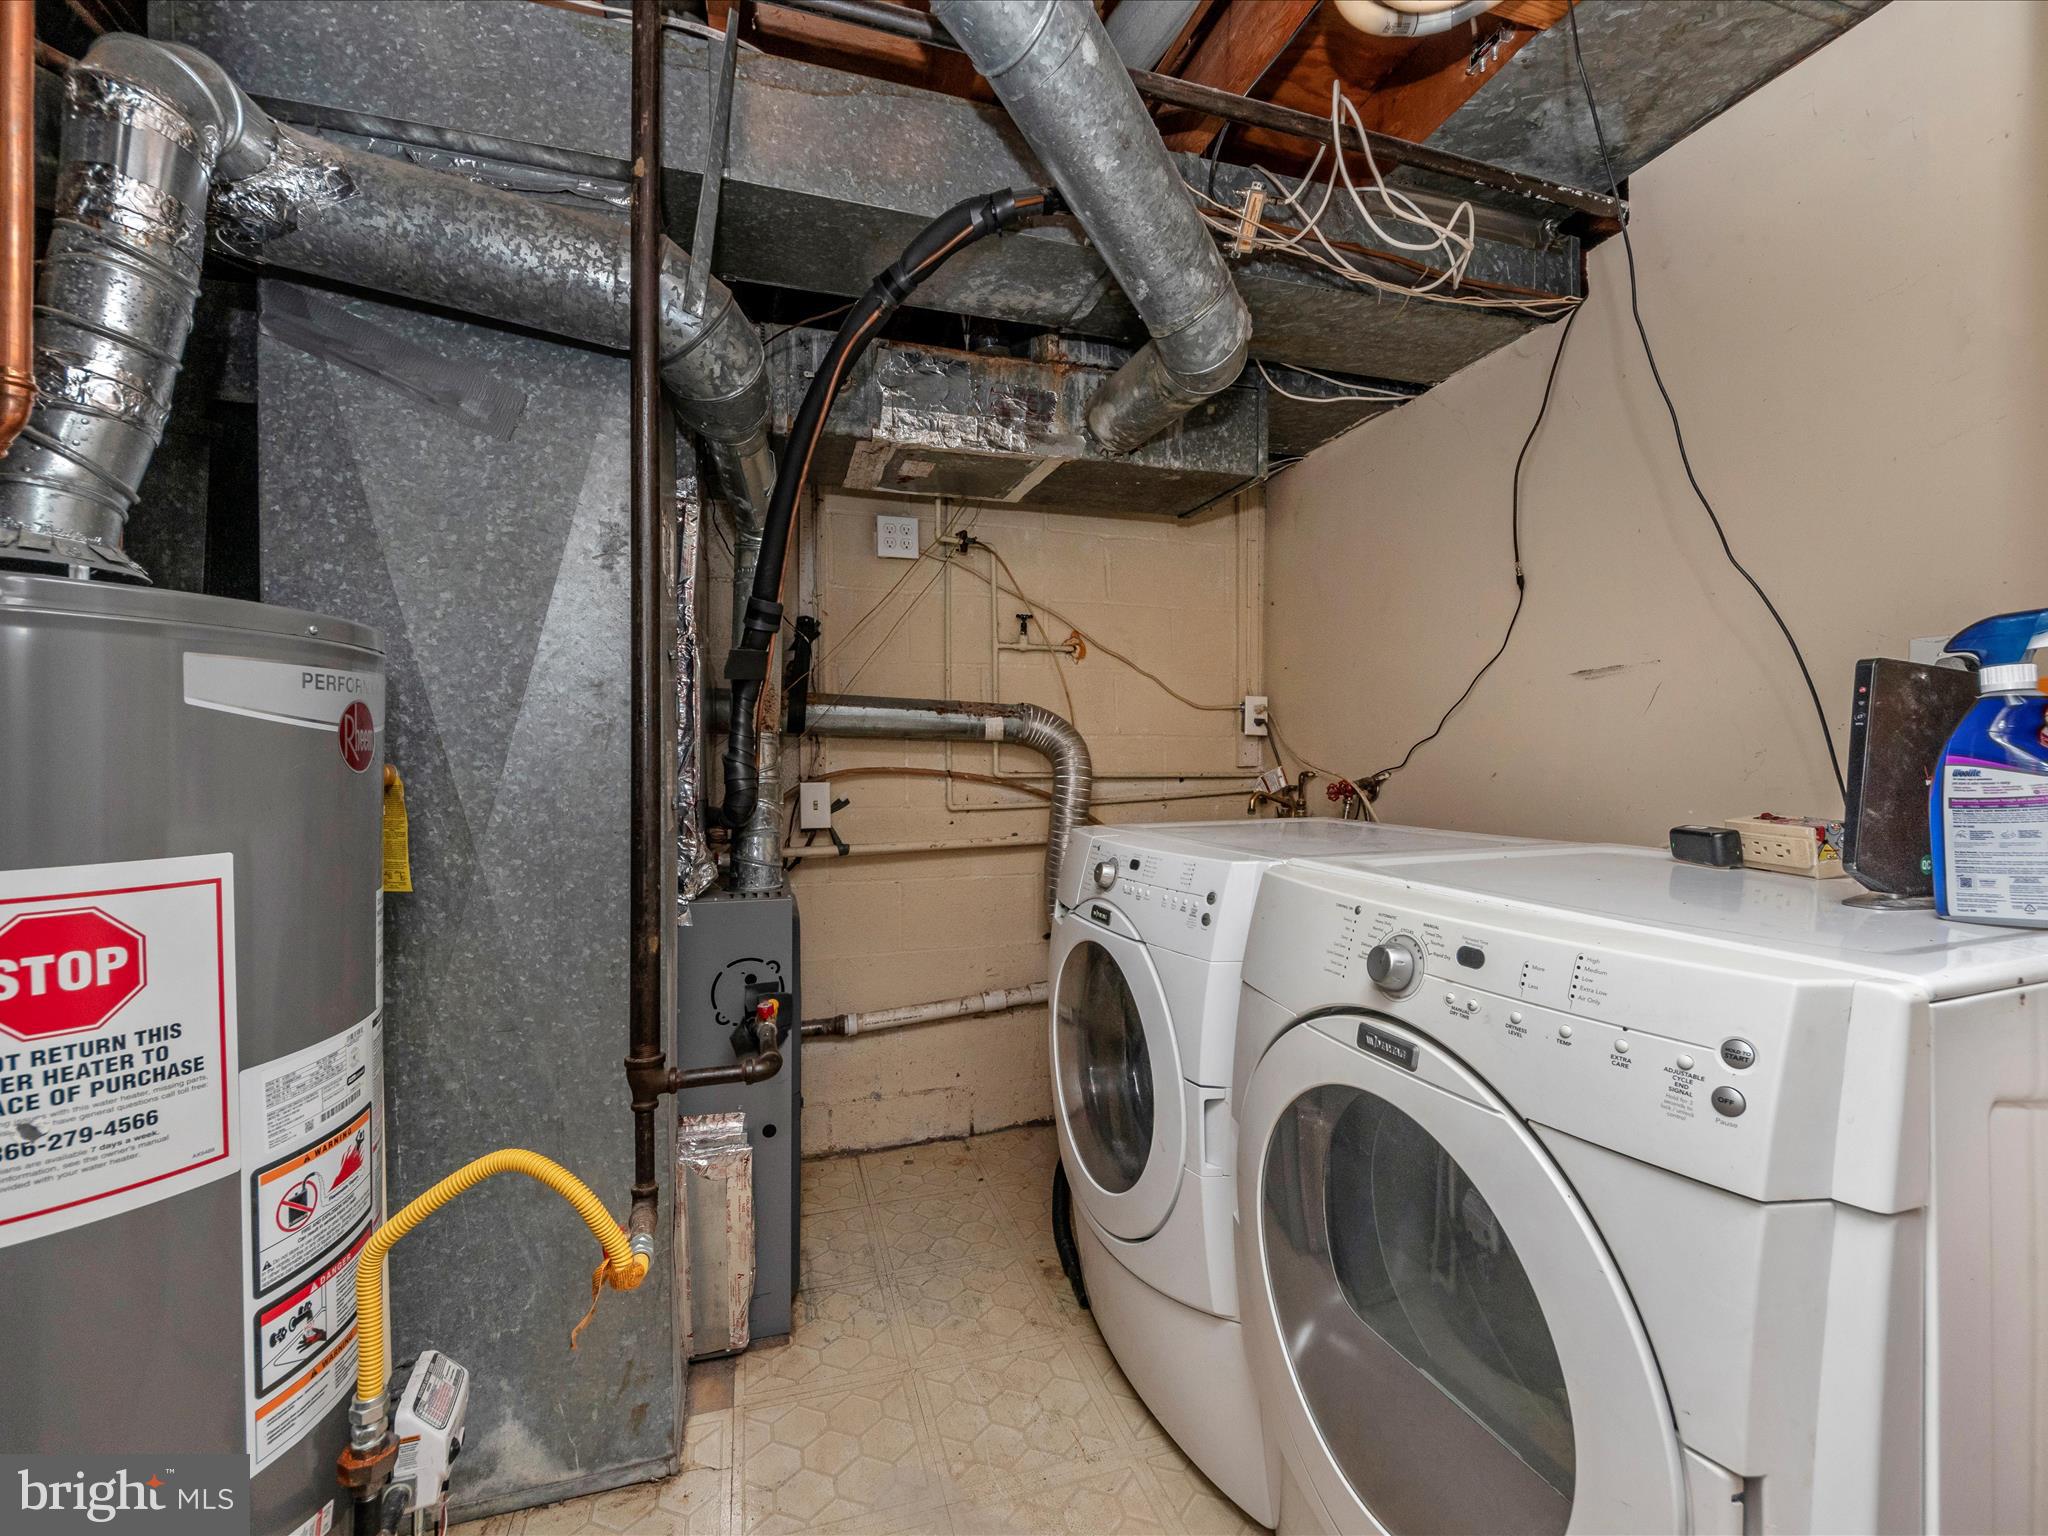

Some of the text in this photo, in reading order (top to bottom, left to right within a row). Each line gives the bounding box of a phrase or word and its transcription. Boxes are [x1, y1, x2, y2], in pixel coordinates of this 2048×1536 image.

[1587, 957, 1600, 965] High
[0, 946, 128, 1001] STOP
[1584, 966, 1607, 976] Medium
[1580, 985, 1607, 997] Extra Low
[1587, 997, 1600, 1006] Only
[1505, 1023, 1527, 1034] DRYNESS
[1508, 1030, 1523, 1039] LEVEL
[31, 1034, 126, 1067] RETURN
[134, 1022, 182, 1047] THIS
[1556, 1038, 1572, 1047] TEMP
[1610, 1054, 1632, 1064] EXTRA
[1724, 1053, 1750, 1063] START
[43, 1053, 134, 1087] HEATER
[143, 1046, 169, 1065] TO
[1611, 1060, 1629, 1070] CARE
[1664, 1066, 1705, 1082] ADJUSTABLE
[1672, 1075, 1693, 1085] CYCLE
[50, 1085, 81, 1106] OF
[91, 1056, 205, 1098] PURCHASE
[152, 1080, 185, 1093] missing
[1674, 1081, 1689, 1090] END
[1668, 1086, 1693, 1098] SIGNAL
[79, 1106, 114, 1120] general
[116, 1096, 159, 1111] questions
[161, 1090, 176, 1099] call
[178, 1086, 190, 1096] toll
[1717, 1096, 1735, 1106] OFF
[1715, 1117, 1738, 1128] Pause
[0, 1109, 158, 1161] 66-279-4566
[99, 1138, 122, 1151] days
[137, 1134, 170, 1150] manual
[315, 1128, 352, 1157] WARNING
[57, 1169, 79, 1180] your
[81, 1161, 108, 1173] water
[320, 1253, 352, 1284] DANGER
